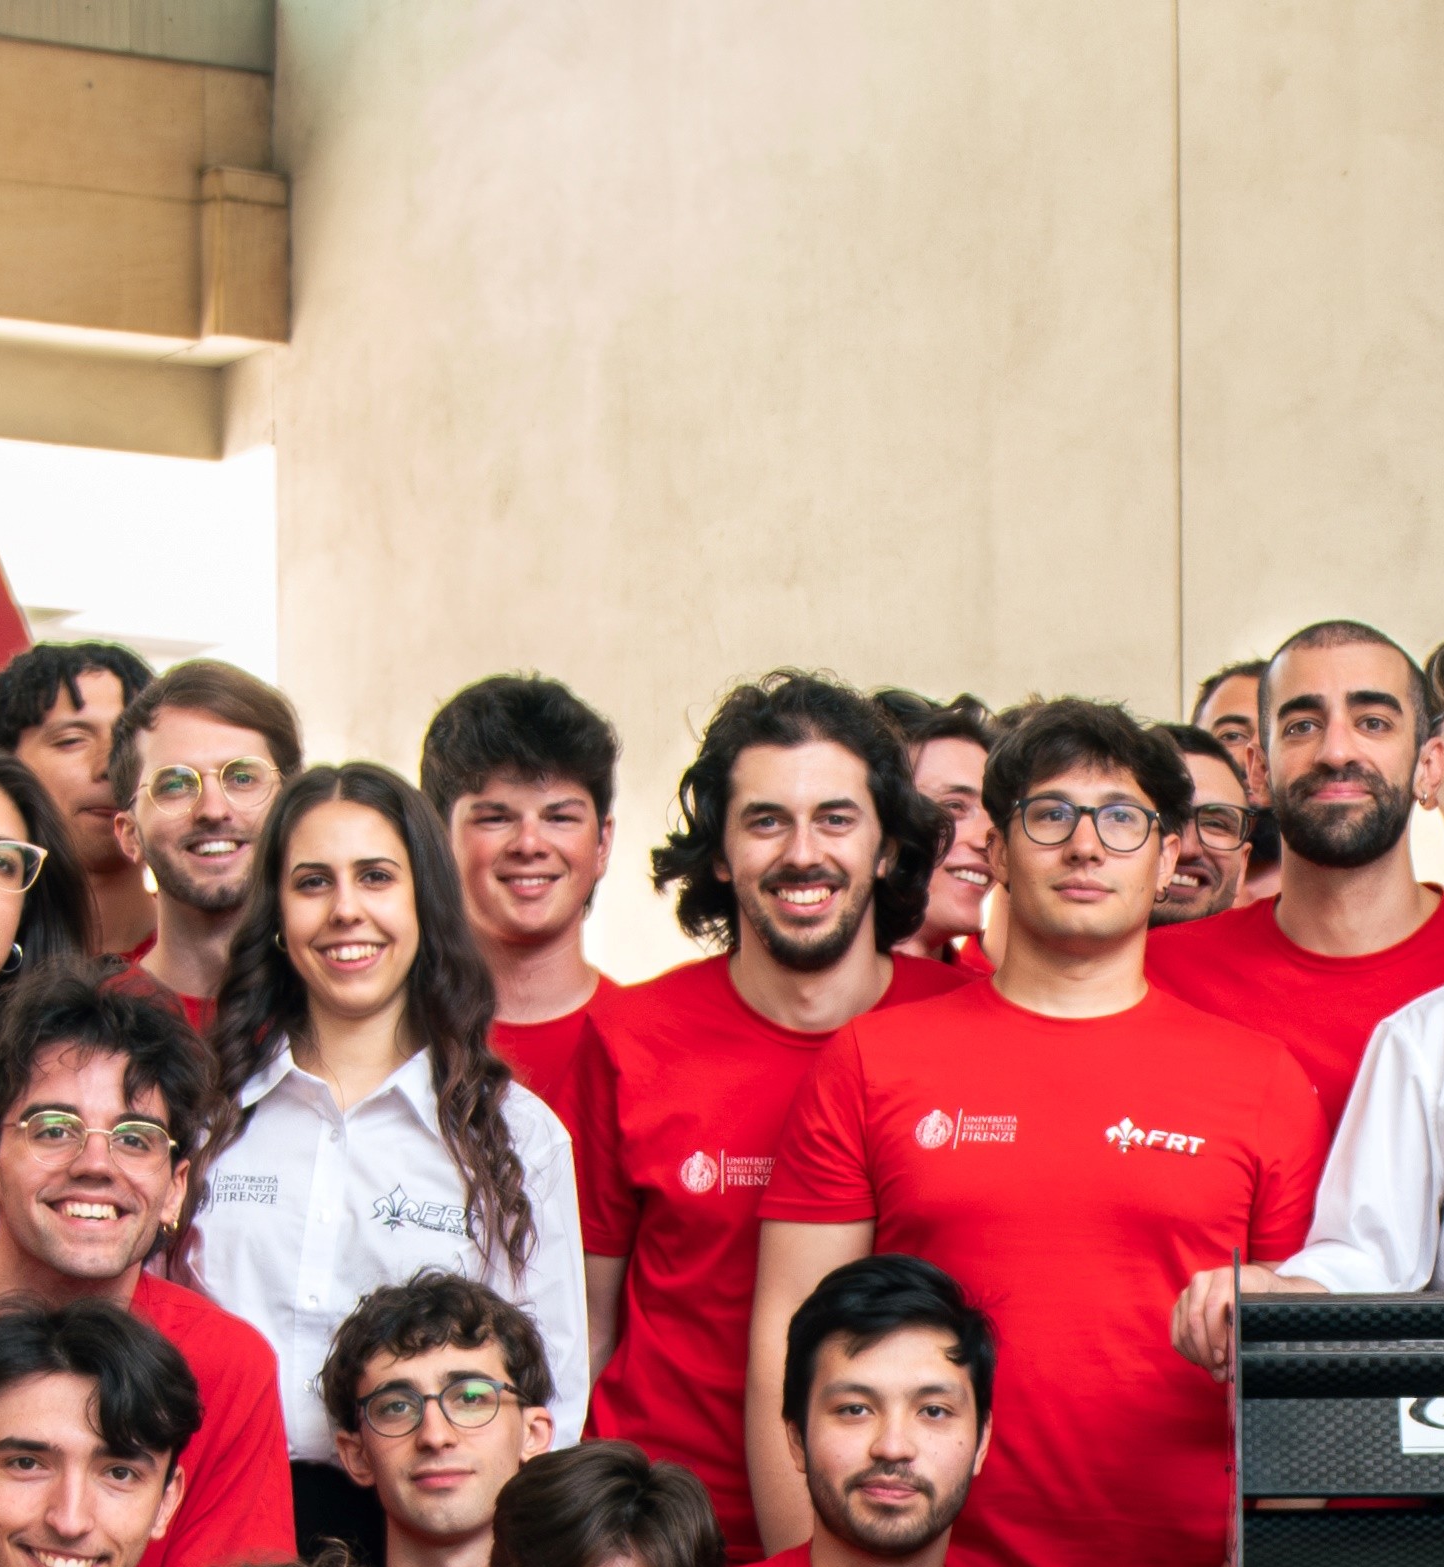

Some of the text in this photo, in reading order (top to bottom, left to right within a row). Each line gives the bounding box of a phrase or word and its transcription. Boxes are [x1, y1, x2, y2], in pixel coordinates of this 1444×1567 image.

[961, 1131, 1016, 1142] FIRENZE
[1146, 1129, 1205, 1155] FRT
[727, 1174, 772, 1186] FIRENZ
[217, 1184, 278, 1193] DEGLI STUDI
[216, 1193, 277, 1204] FIRENZE
